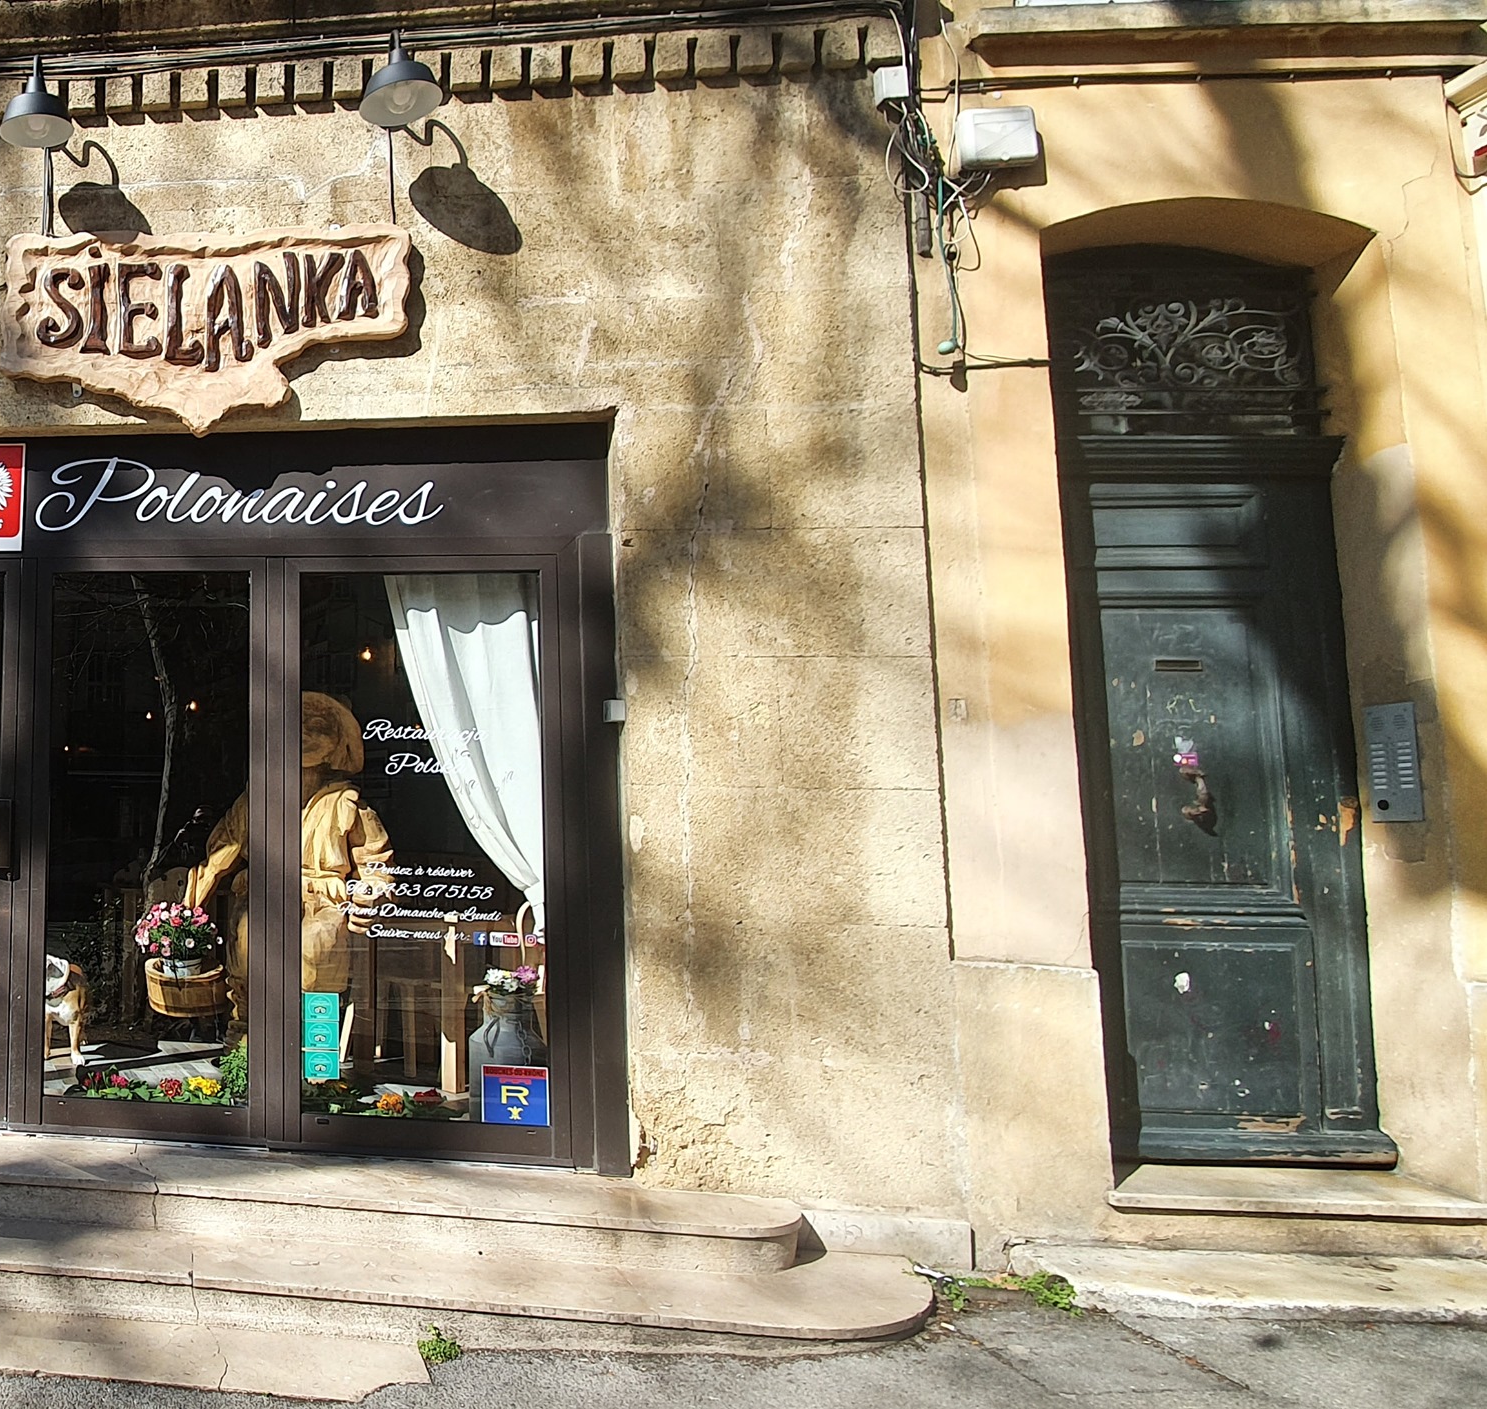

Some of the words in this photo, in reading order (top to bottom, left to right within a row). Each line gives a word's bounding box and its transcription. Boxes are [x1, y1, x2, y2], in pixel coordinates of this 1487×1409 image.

[36, 246, 380, 371] SIELANKA
[35, 456, 444, 532] Polonaises
[385, 752, 465, 775] Pols
[364, 862, 413, 876] Pensez
[414, 865, 424, 876] à
[425, 866, 475, 878] réserver
[379, 903, 445, 918] Dimanche
[459, 906, 502, 922] Lundi
[501, 1085, 529, 1106] R
